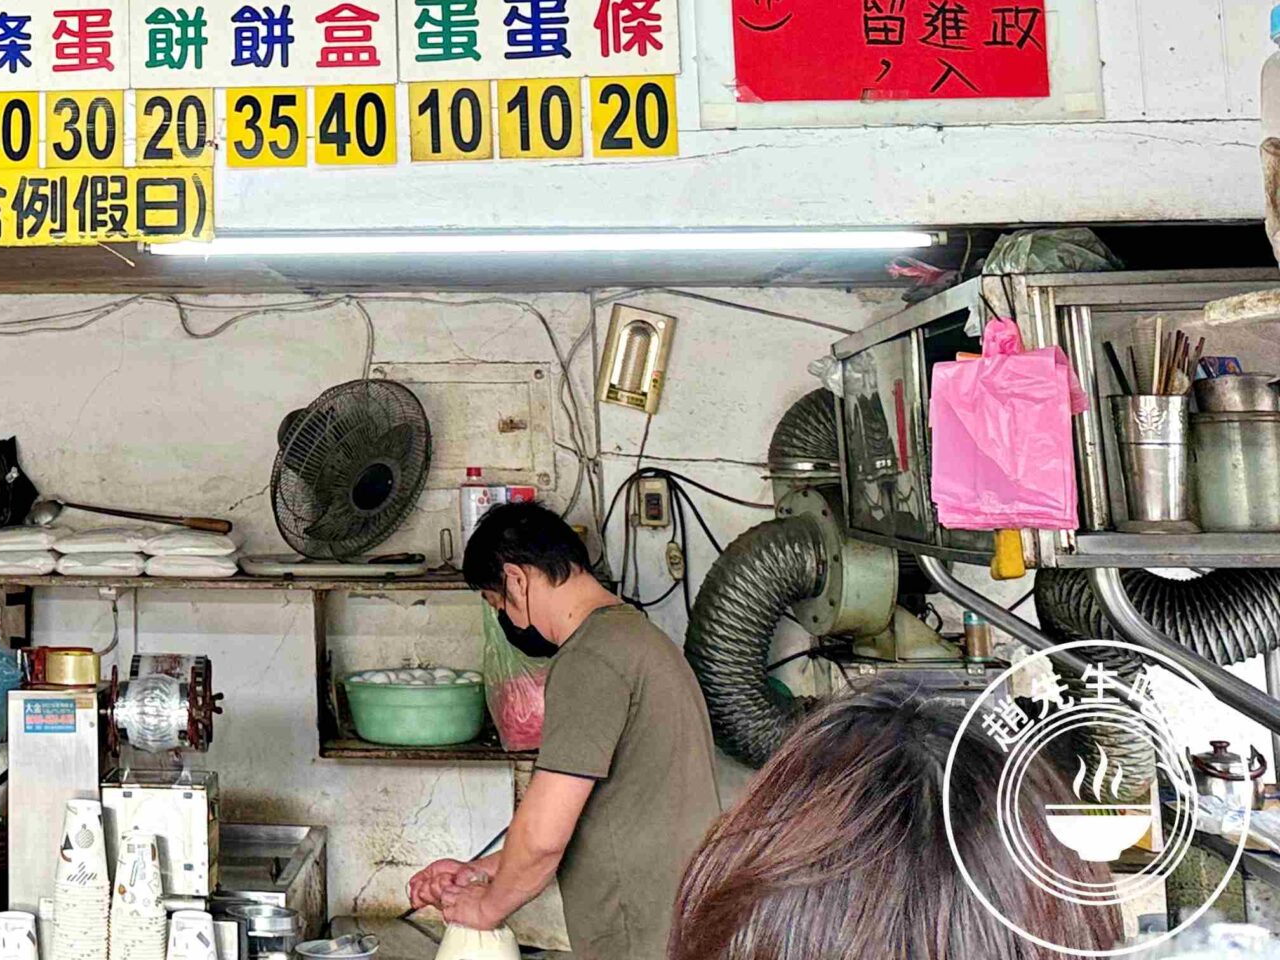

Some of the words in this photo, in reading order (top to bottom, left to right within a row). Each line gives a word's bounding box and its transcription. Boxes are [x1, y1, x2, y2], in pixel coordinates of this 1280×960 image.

[54, 97, 117, 162] 30
[143, 96, 208, 161] 20
[233, 94, 299, 159] 35
[319, 91, 387, 157] 40
[417, 88, 482, 154] 10
[506, 84, 572, 152] 10
[599, 82, 670, 150] 20
